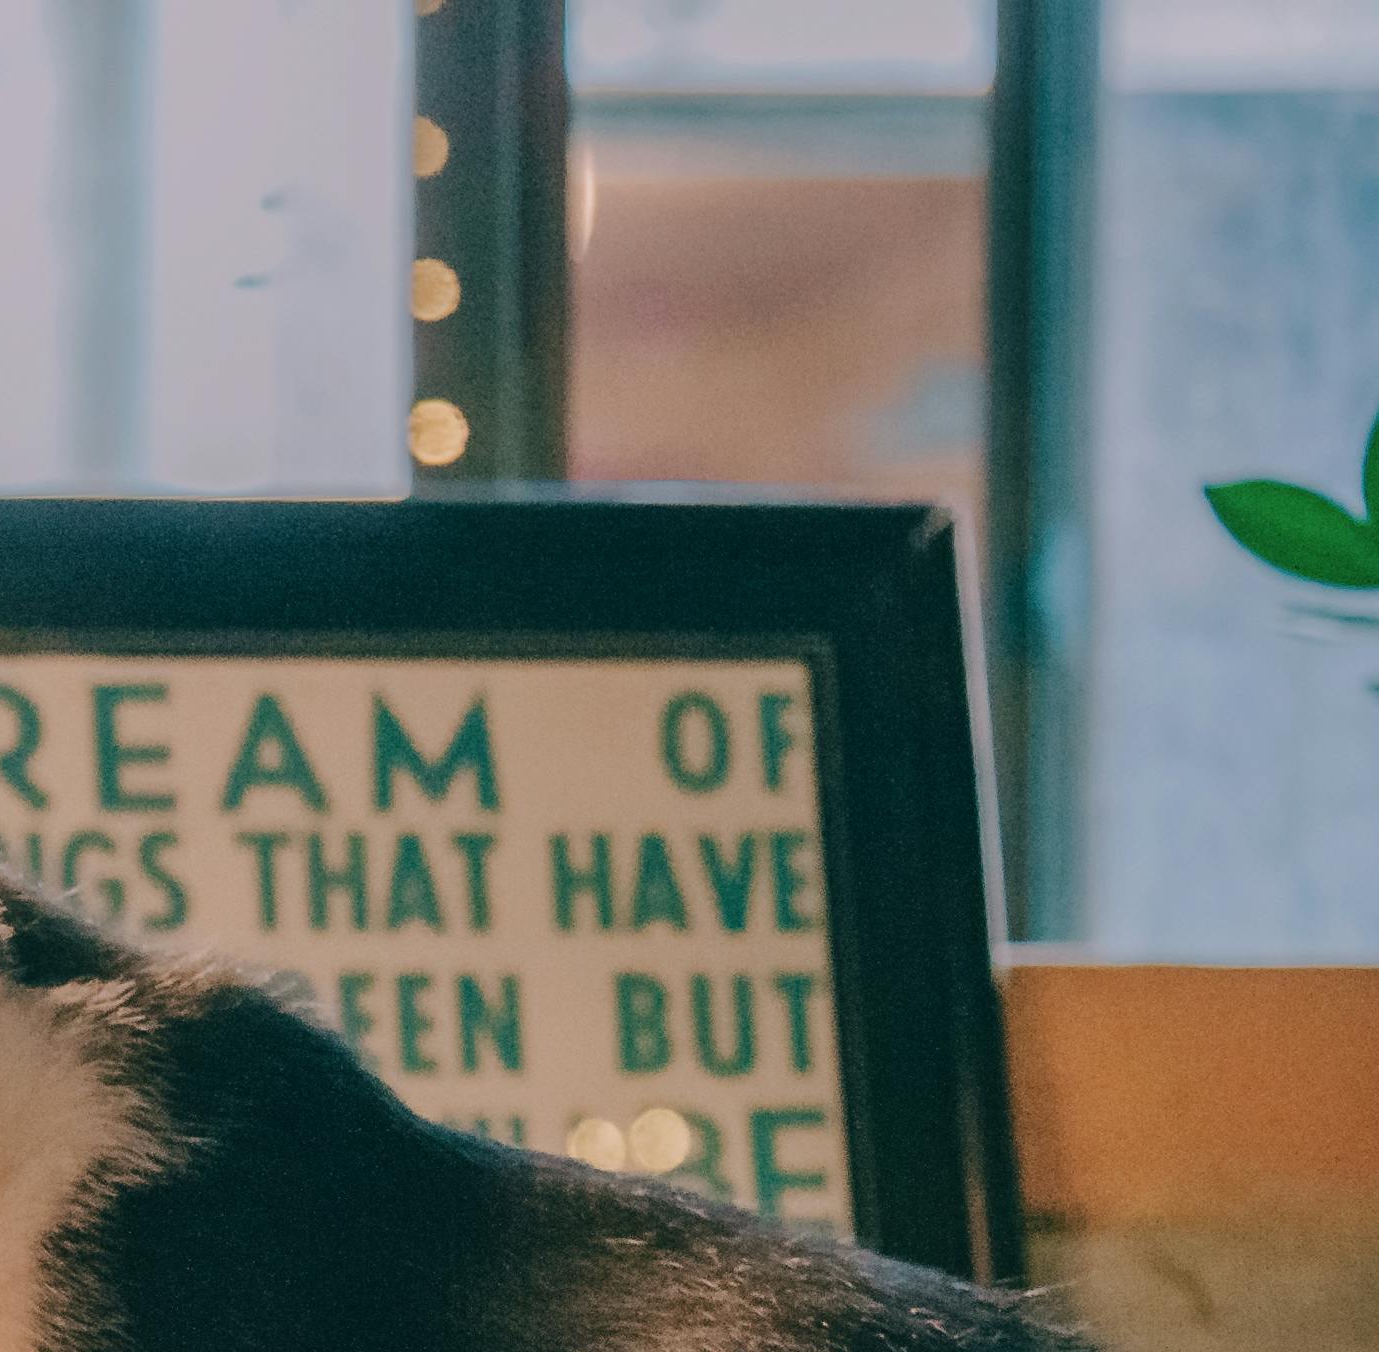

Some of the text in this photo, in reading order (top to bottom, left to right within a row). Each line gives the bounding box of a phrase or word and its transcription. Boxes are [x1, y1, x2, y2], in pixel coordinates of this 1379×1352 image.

[658, 690, 797, 793] OF
[237, 831, 495, 930] THAT
[550, 831, 812, 932] HAVE
[616, 971, 814, 1076] BUT
